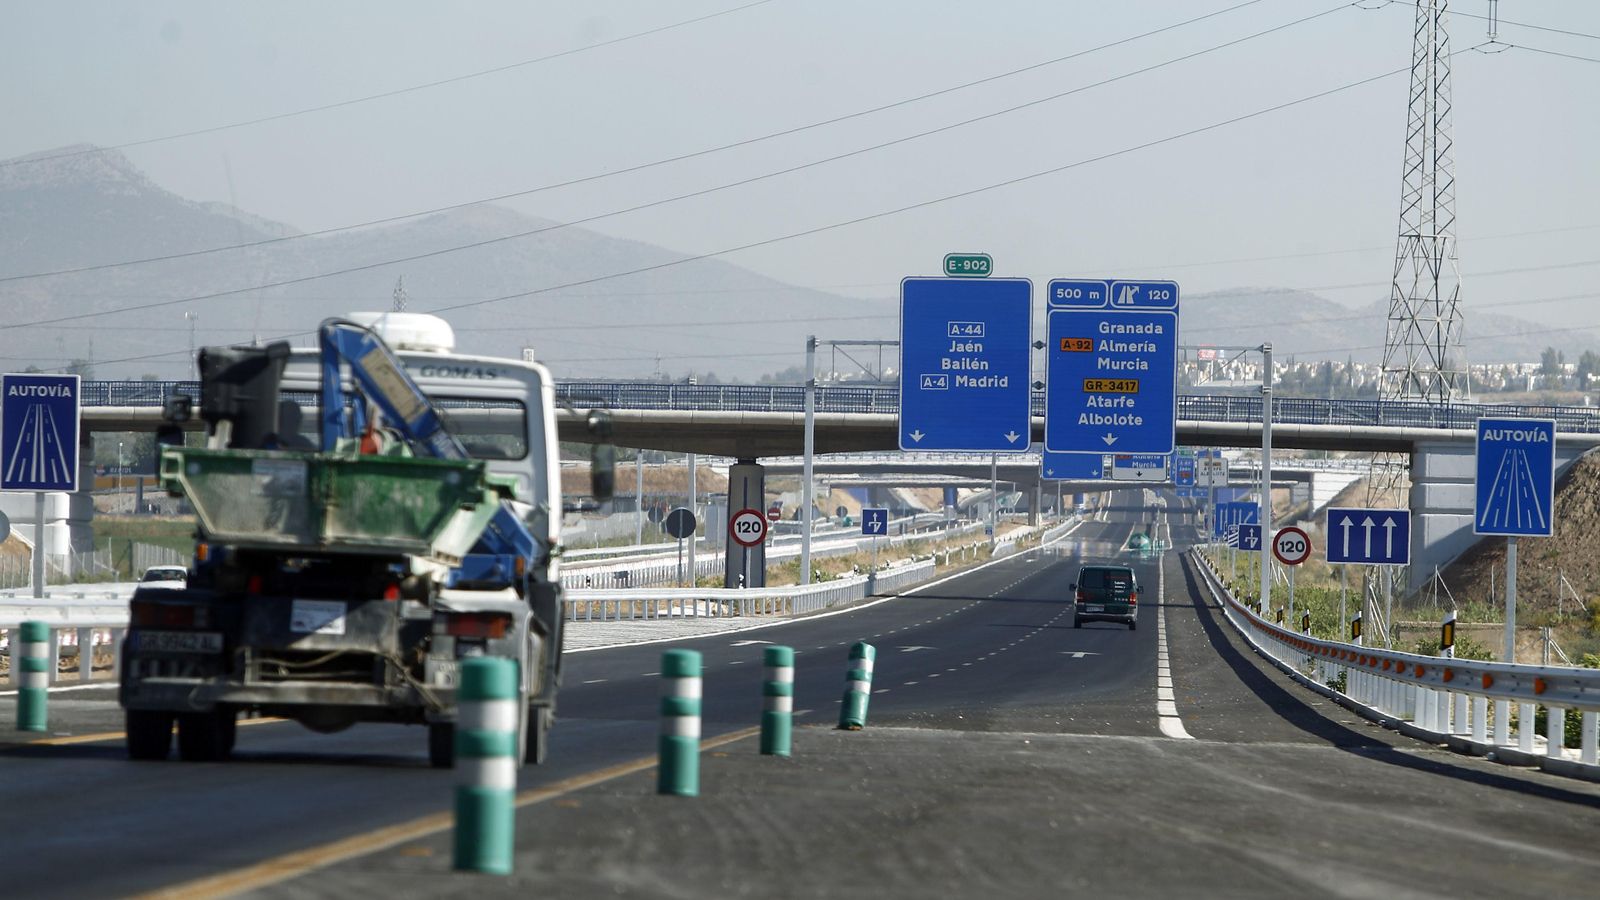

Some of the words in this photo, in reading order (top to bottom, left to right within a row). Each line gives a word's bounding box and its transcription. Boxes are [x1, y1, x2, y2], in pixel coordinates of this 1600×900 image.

[948, 260, 988, 271] E-902
[1056, 288, 1082, 299] 500
[1089, 290, 1100, 299] m
[1148, 289, 1170, 300] 120
[951, 324, 982, 335] A-44
[1098, 321, 1163, 335] Granada
[949, 340, 983, 353] Jaén
[1063, 340, 1091, 350] A-92
[1098, 339, 1157, 353] Almería
[941, 357, 989, 371] Bailén
[1097, 357, 1149, 371] Murcia
[420, 364, 497, 379] GOMAS
[923, 376, 946, 388] A-4
[955, 375, 1009, 388] Madrid
[1085, 380, 1136, 391] GR-3417
[8, 384, 72, 397] AUTOVÍA
[1086, 395, 1135, 408] Atarfe
[1078, 412, 1143, 426] Albolote
[1482, 427, 1549, 442] AUTOVÍA
[736, 521, 761, 534] 120
[1279, 541, 1305, 553] 120
